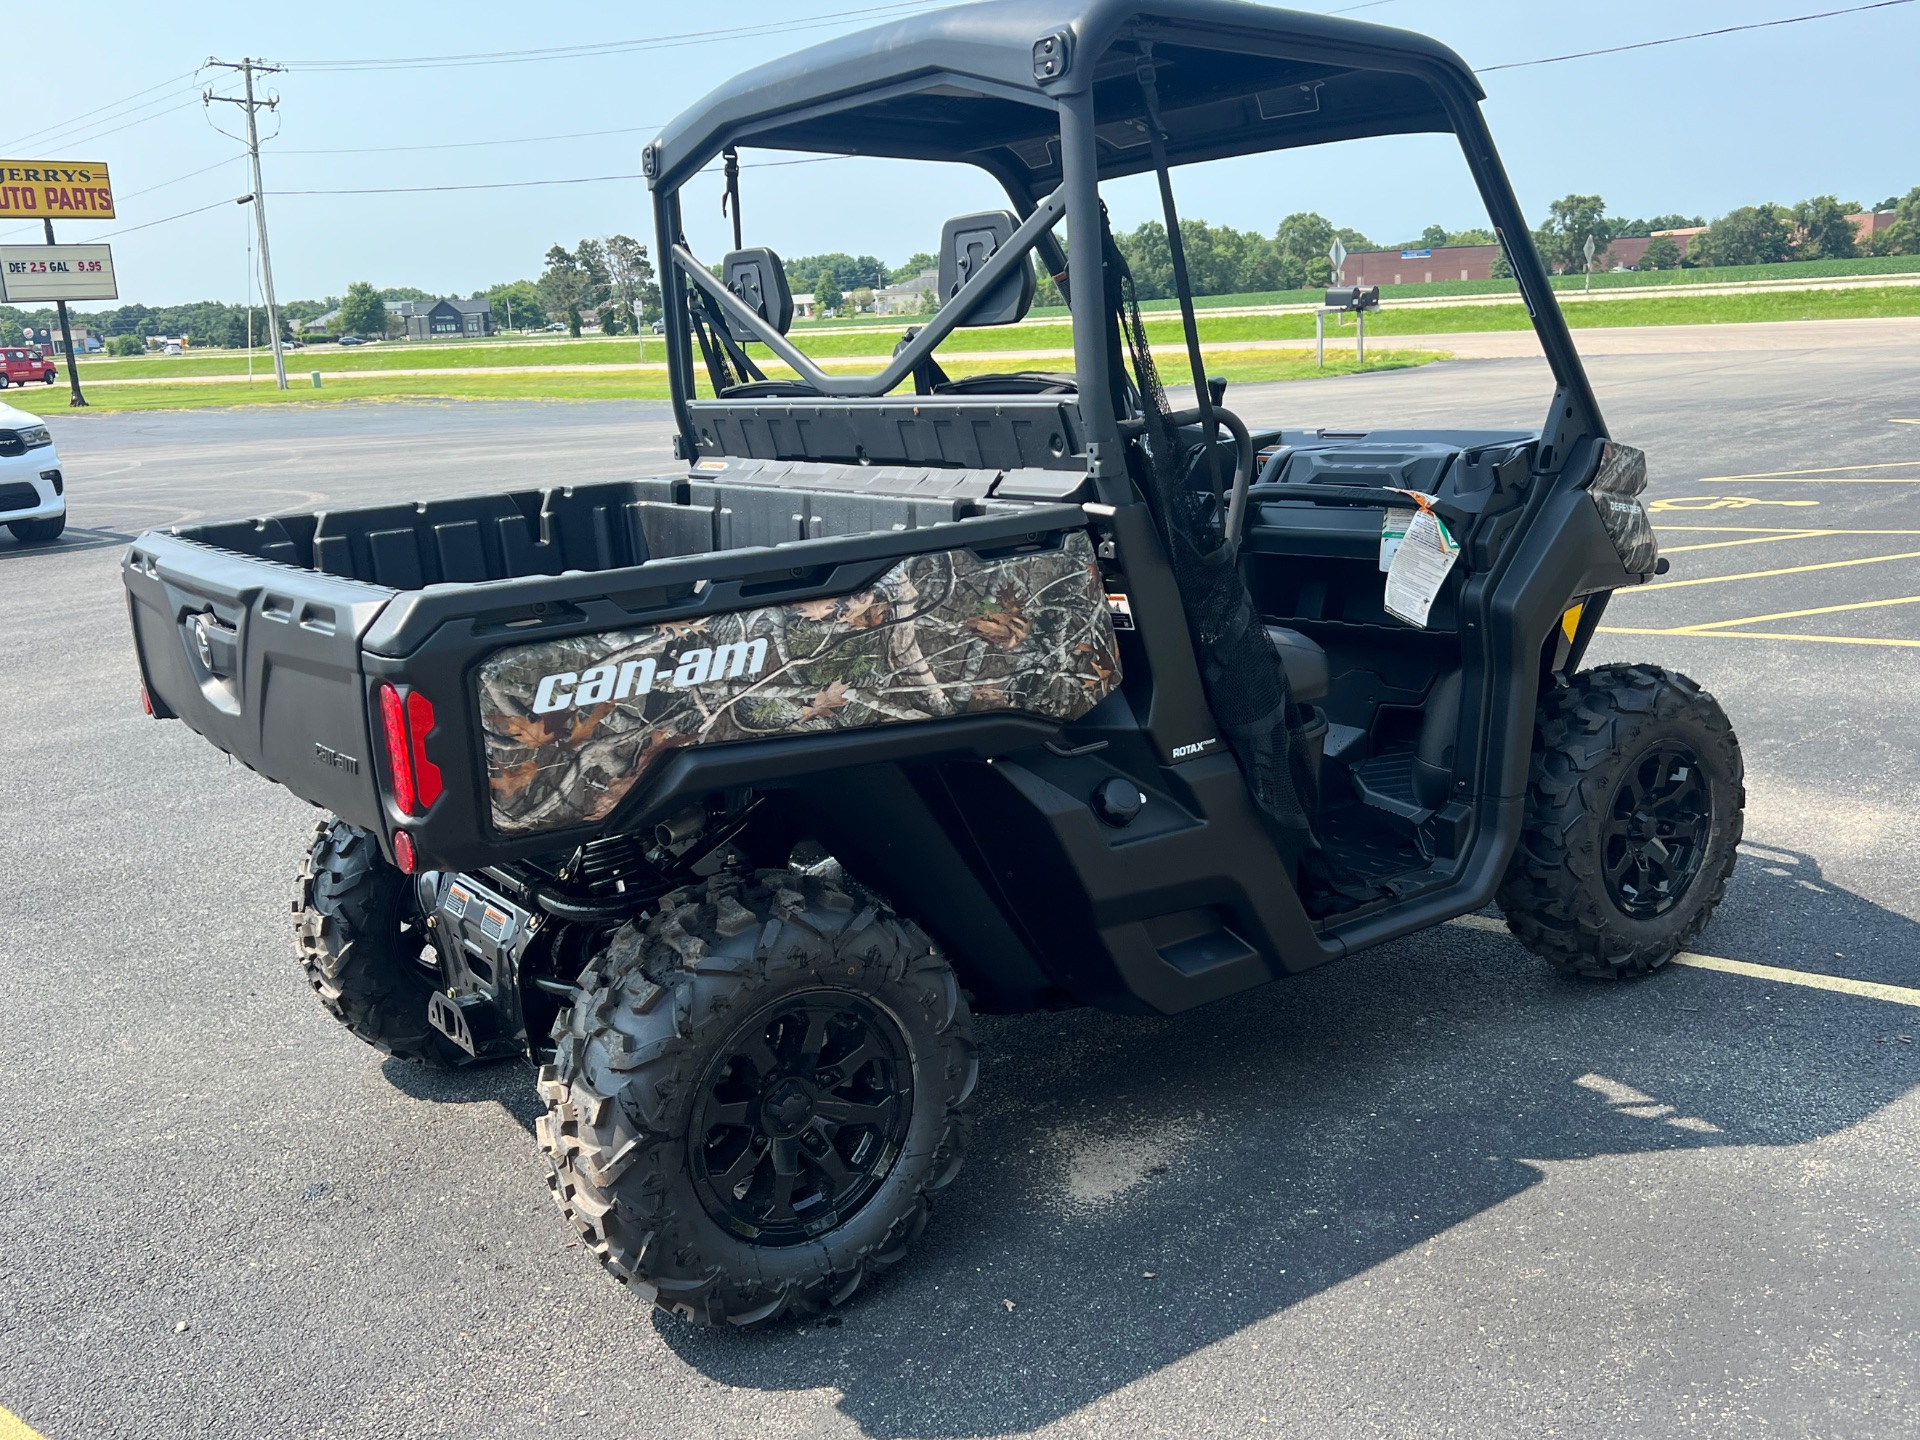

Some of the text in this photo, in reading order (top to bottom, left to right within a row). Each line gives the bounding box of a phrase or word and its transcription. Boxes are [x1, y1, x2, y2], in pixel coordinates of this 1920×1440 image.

[44, 186, 112, 210] PARTS
[9, 261, 102, 273] DEF 2.5 GAL 9.95
[532, 637, 768, 714] can-am
[1172, 742, 1204, 758] ROTAX
